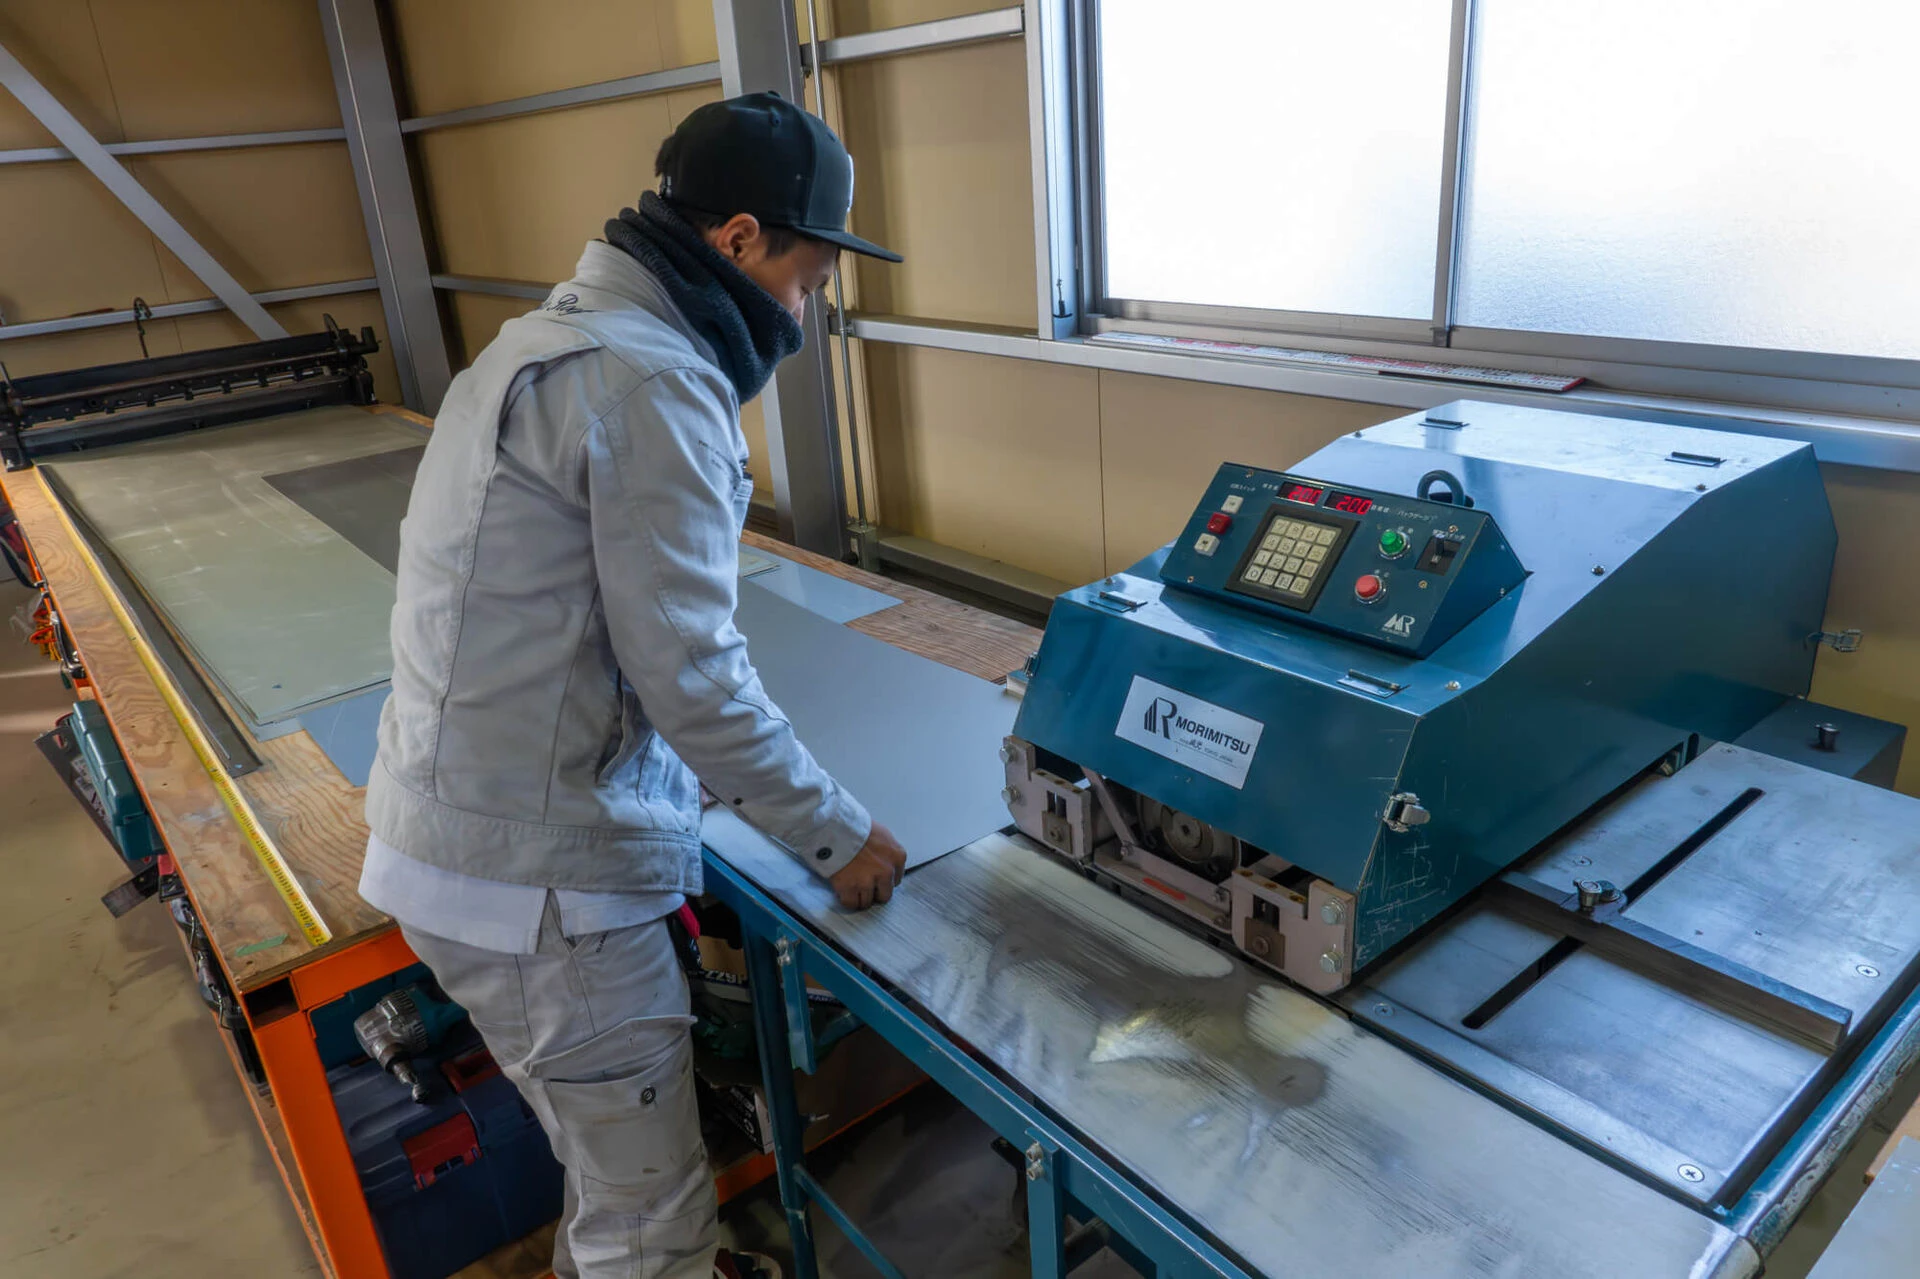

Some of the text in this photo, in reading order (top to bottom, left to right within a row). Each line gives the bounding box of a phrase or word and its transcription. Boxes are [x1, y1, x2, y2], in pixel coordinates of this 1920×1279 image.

[1288, 485, 1323, 504] 200
[1336, 496, 1373, 515] 200
[1176, 716, 1250, 755] MORIMITSU
